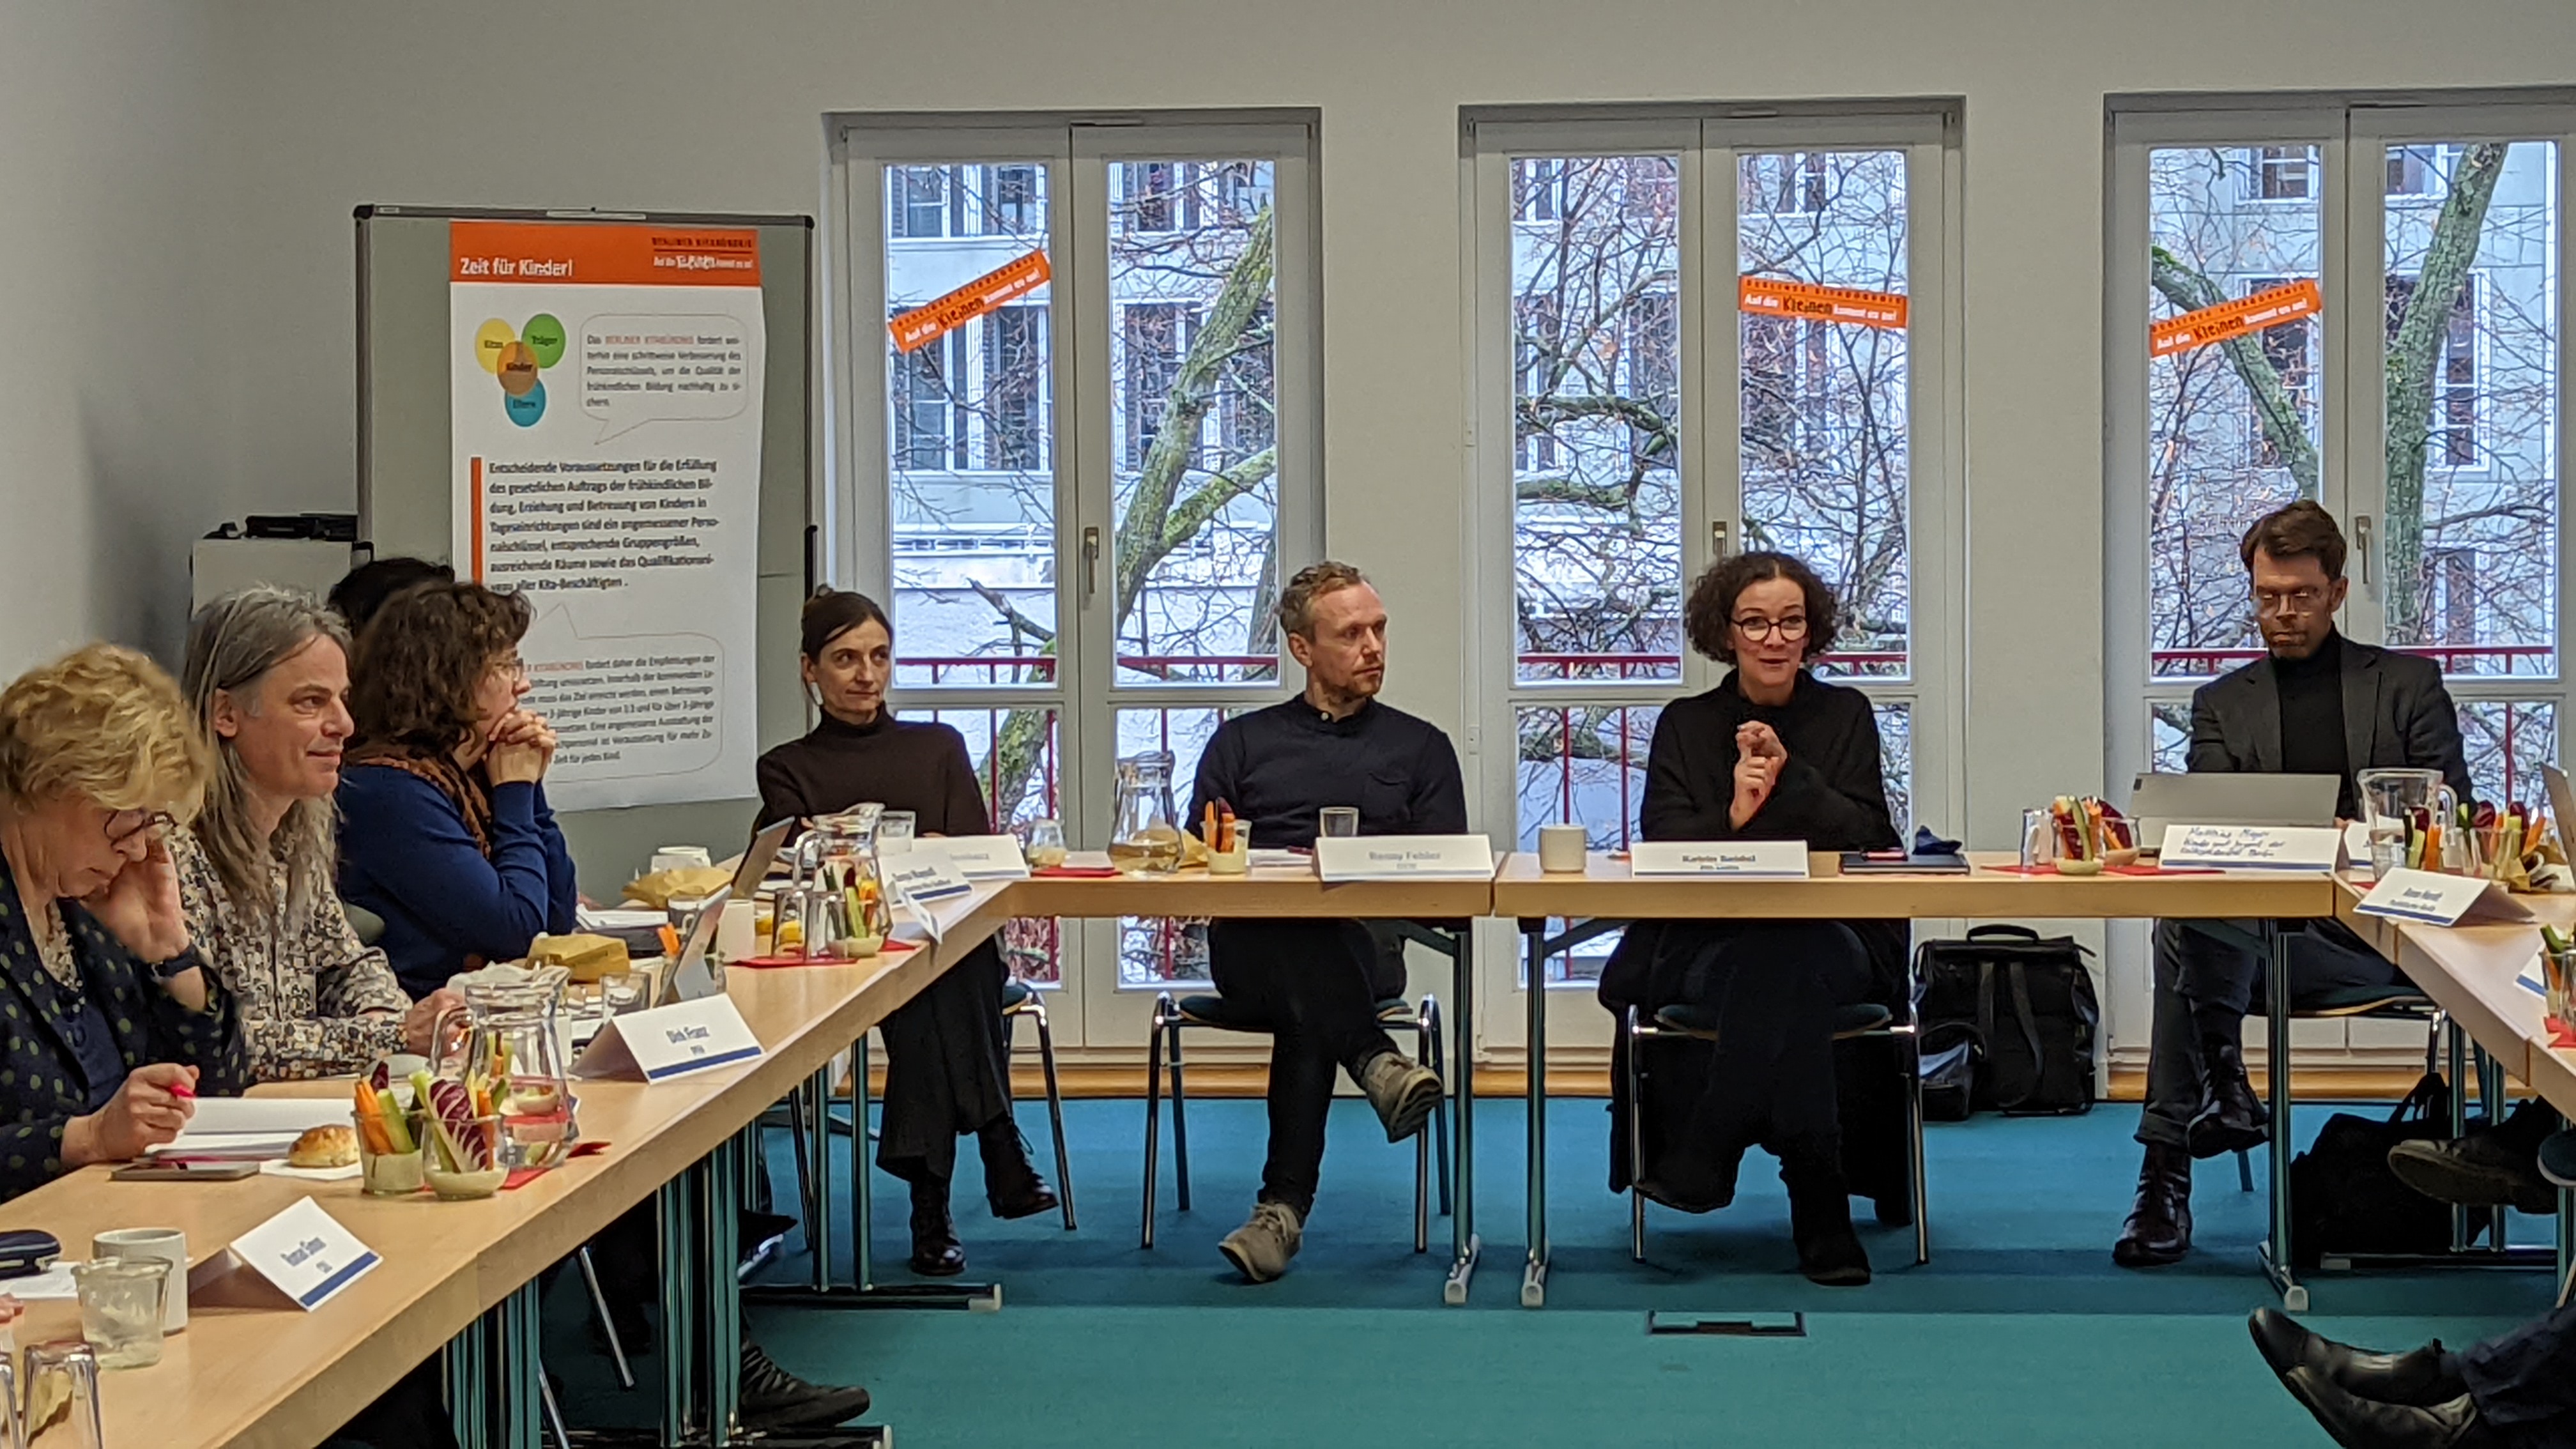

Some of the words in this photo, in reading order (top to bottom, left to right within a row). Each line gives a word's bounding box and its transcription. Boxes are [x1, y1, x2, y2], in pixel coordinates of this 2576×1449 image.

[461, 257, 489, 275] Zeit
[493, 257, 514, 275] für
[519, 259, 574, 276] Kinder!
[1745, 293, 1762, 305] Auf
[1763, 295, 1779, 308] die
[1782, 296, 1833, 314] Kleinen
[937, 298, 985, 329] Kleinen
[2193, 316, 2244, 341] Kleinen
[489, 462, 557, 473] Entscheidende
[559, 462, 640, 473] Voraussetzungen
[643, 460, 657, 471] für
[659, 459, 673, 471] die
[676, 459, 716, 473] Erfüllung
[489, 483, 506, 494] des
[509, 481, 565, 496] gesetzlichen
[567, 480, 607, 494] Auftrags
[610, 480, 625, 491] der
[628, 479, 696, 491] frühkindlichen
[519, 500, 564, 514] Erziehung
[566, 500, 585, 511] und
[587, 500, 636, 512] Betreuung
[640, 501, 656, 509] von
[659, 497, 695, 509] Kindern
[698, 497, 707, 508] in
[582, 519, 602, 530] sind
[604, 518, 618, 530] ein
[555, 558, 586, 570] Räume
[590, 557, 616, 569] sowie
[619, 556, 636, 568] das
